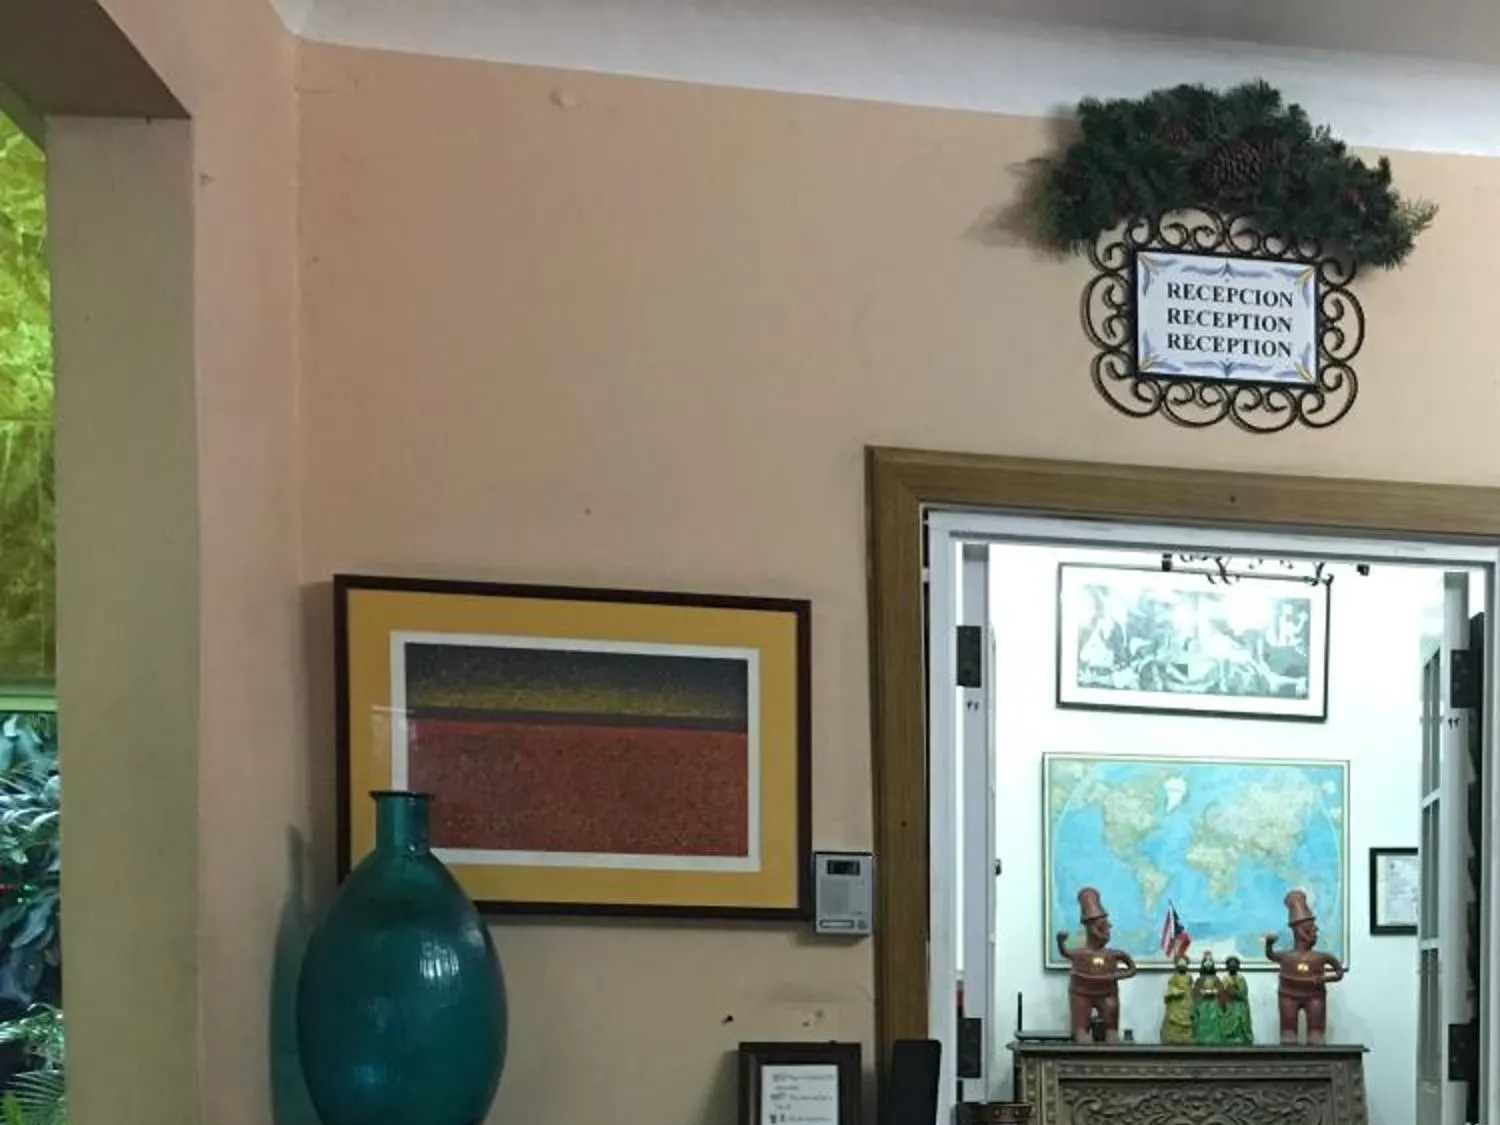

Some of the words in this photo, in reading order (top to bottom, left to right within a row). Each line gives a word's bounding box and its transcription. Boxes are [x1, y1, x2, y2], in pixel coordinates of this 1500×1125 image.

[1167, 282, 1294, 308] RECEPCION
[1167, 308, 1293, 333] RECEPTION
[1167, 333, 1292, 358] RECEPTION
